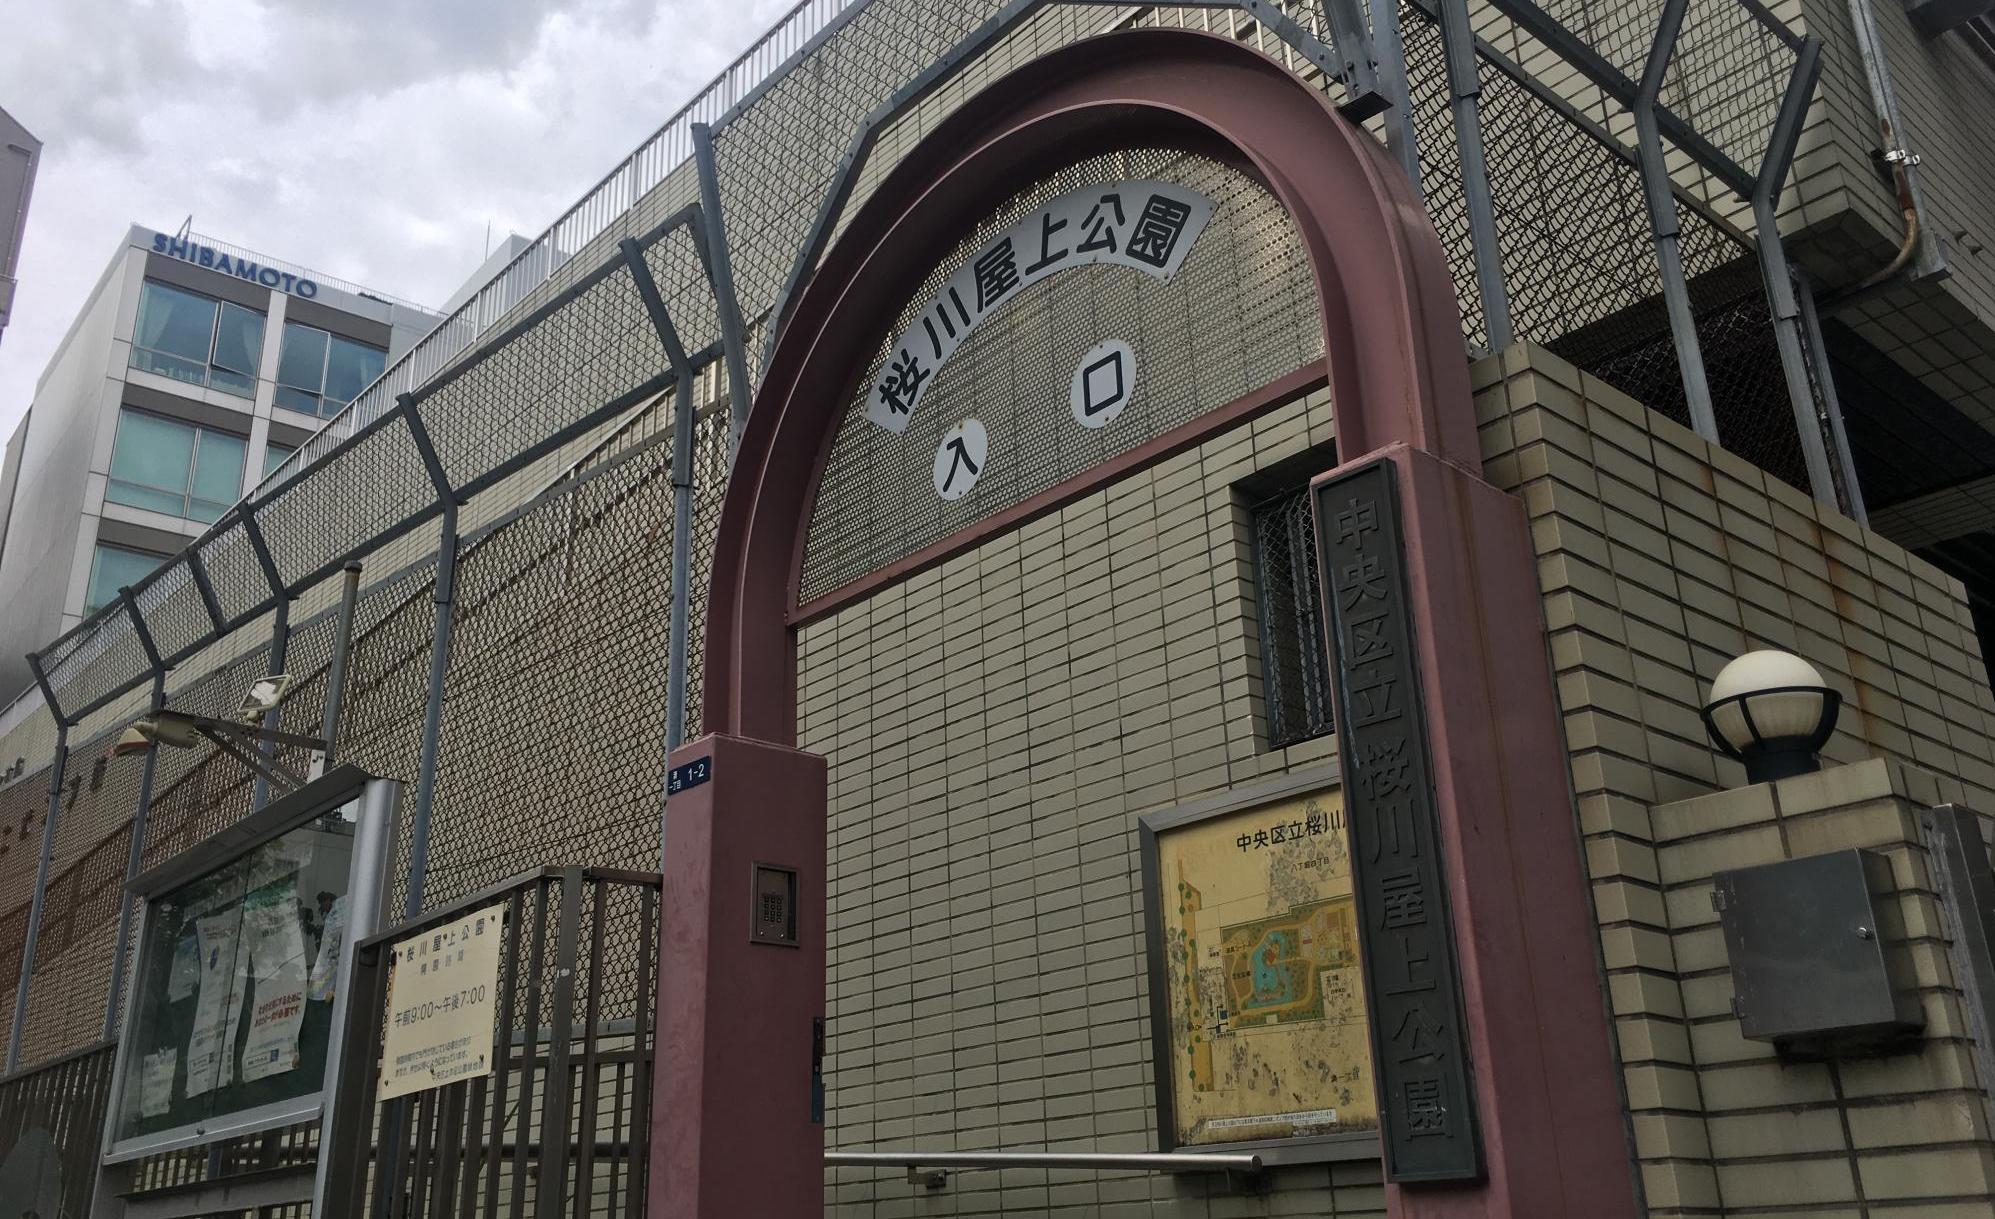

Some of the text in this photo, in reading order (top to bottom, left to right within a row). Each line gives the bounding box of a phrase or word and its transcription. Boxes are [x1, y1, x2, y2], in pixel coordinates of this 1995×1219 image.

[153, 233, 318, 298] SHIBAMOTO
[878, 193, 1192, 416] 桜川屋上公園
[687, 763, 705, 781] 1-2
[1236, 809, 1346, 853] 中央区立桜川
[1336, 498, 1454, 1145] 中央区立桜川屋上公園
